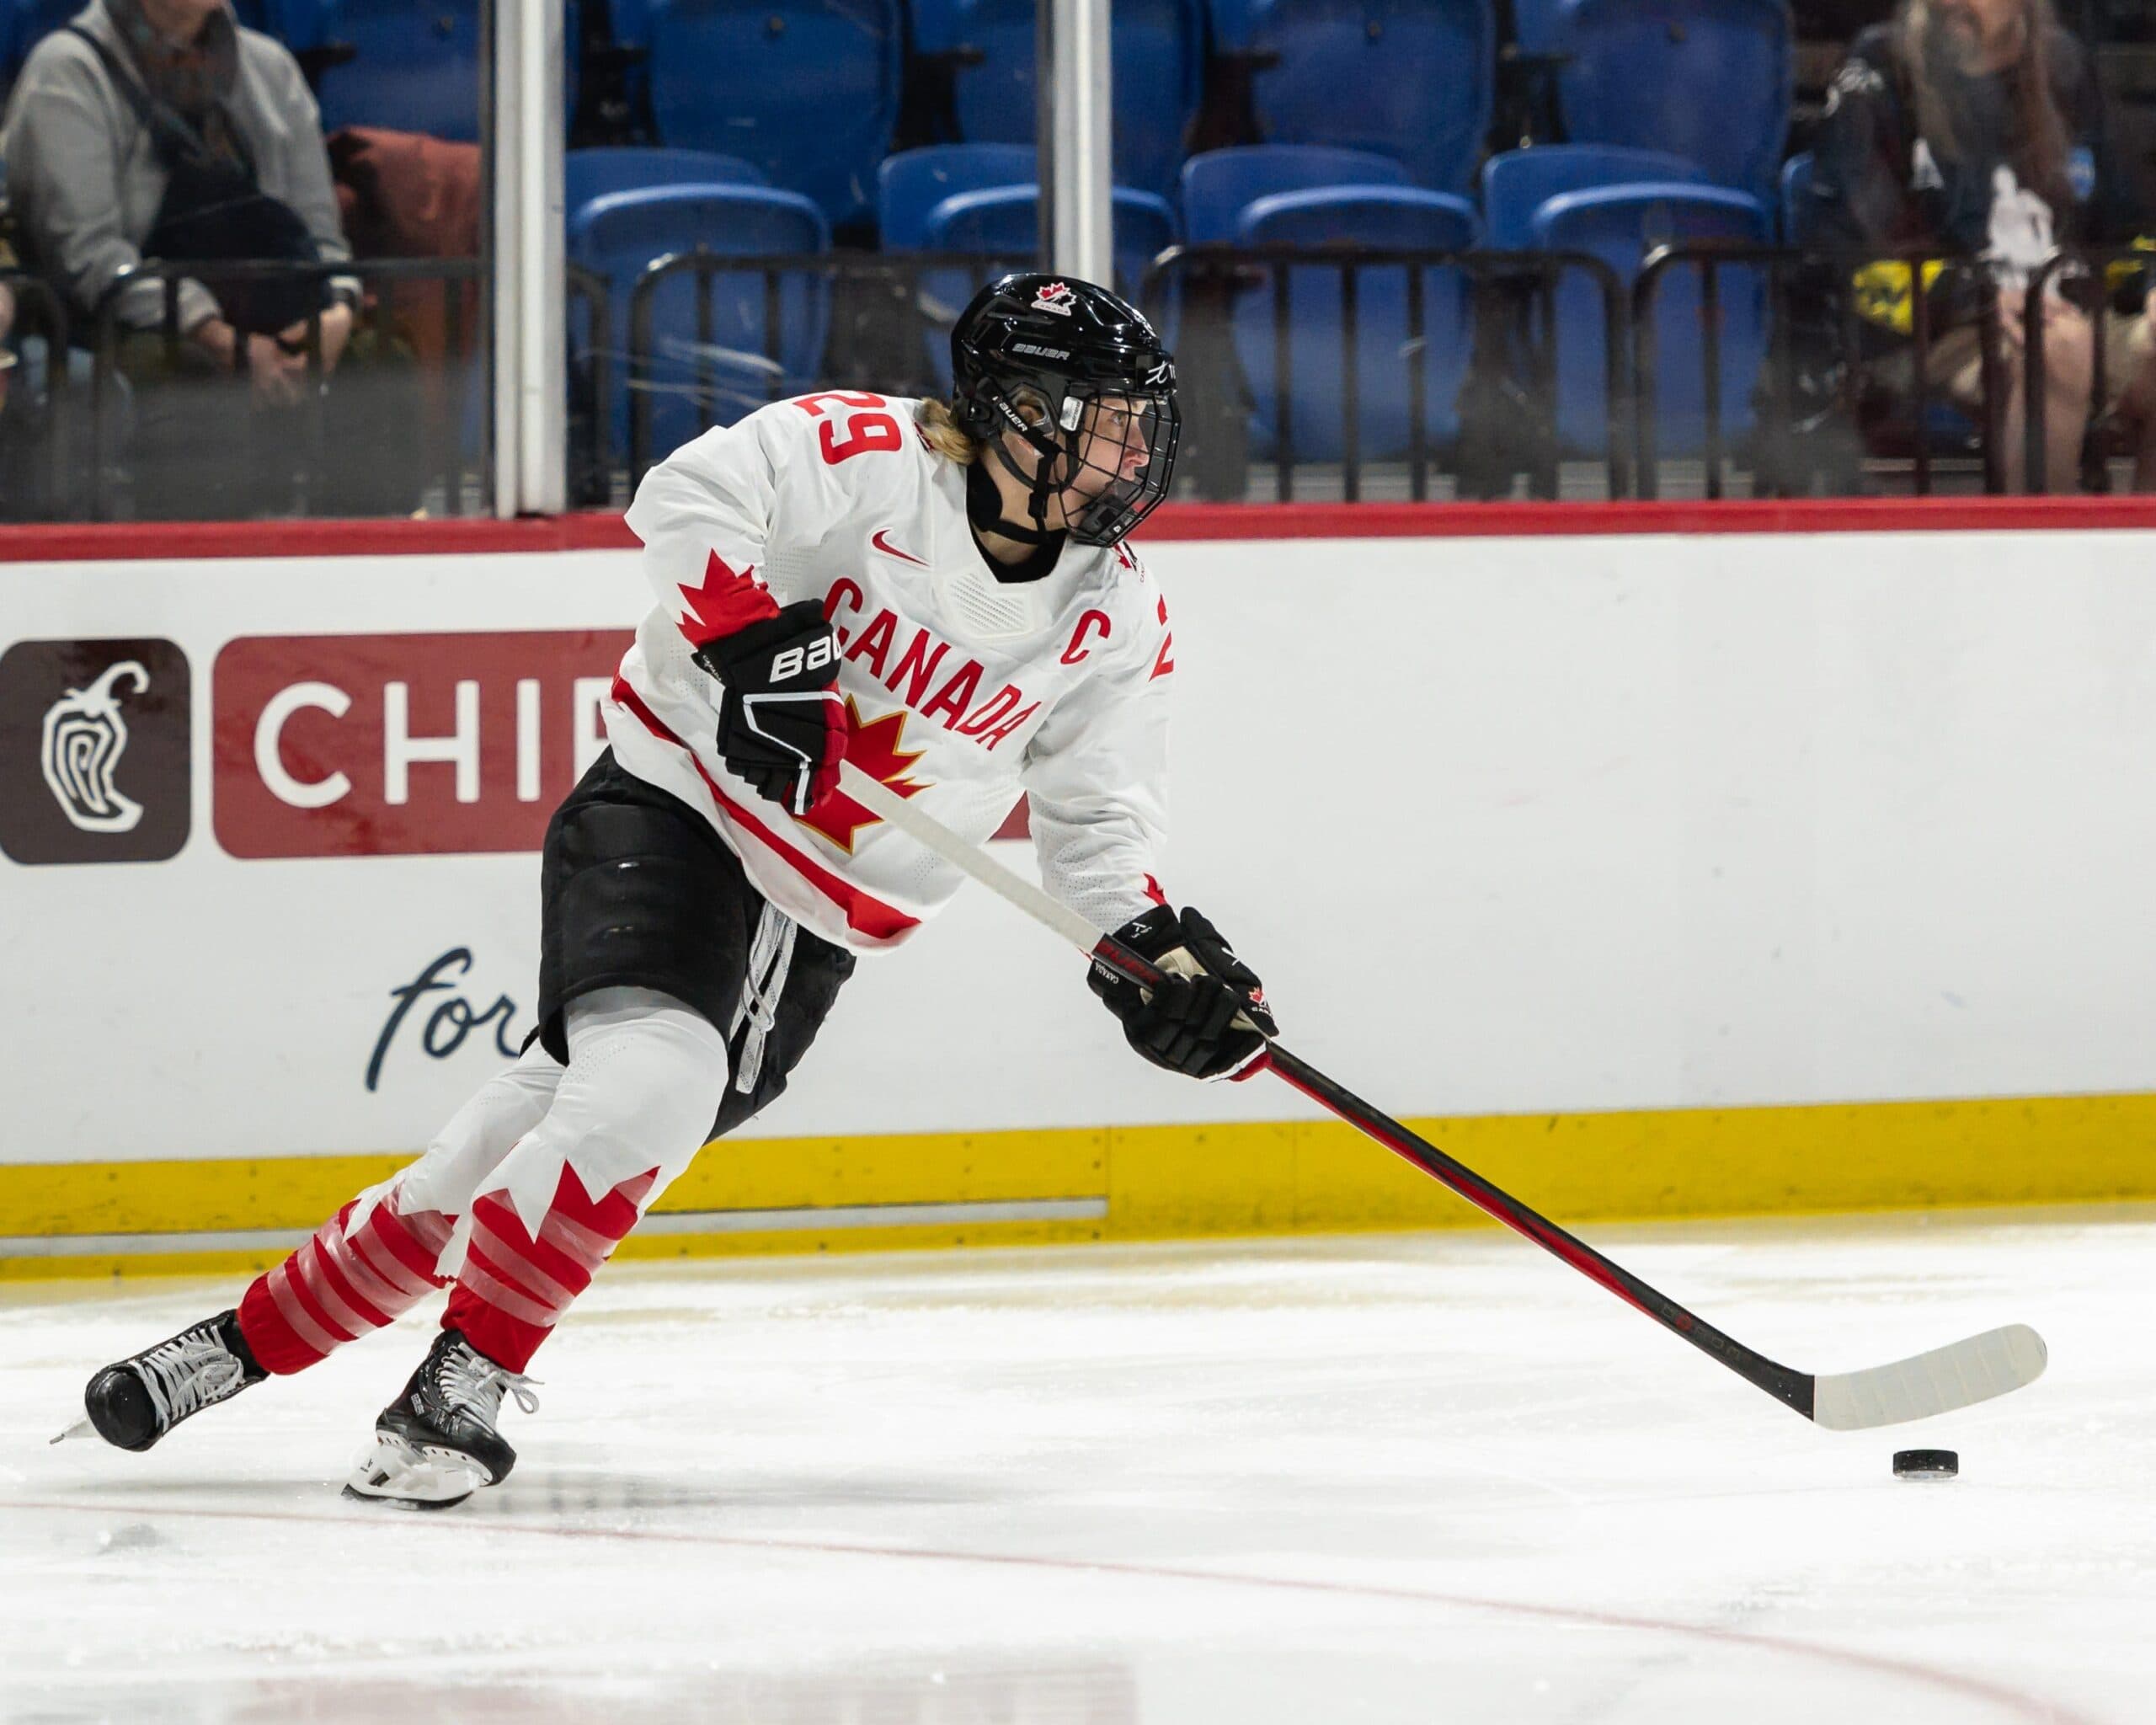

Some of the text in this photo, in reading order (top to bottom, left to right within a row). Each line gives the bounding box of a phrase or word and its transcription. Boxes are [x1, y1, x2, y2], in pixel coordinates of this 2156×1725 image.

[792, 391, 903, 466] 29
[992, 395, 1028, 431] AUER
[823, 577, 1043, 751] CANADA
[1060, 608, 1112, 665] C
[366, 947, 520, 1092] for
